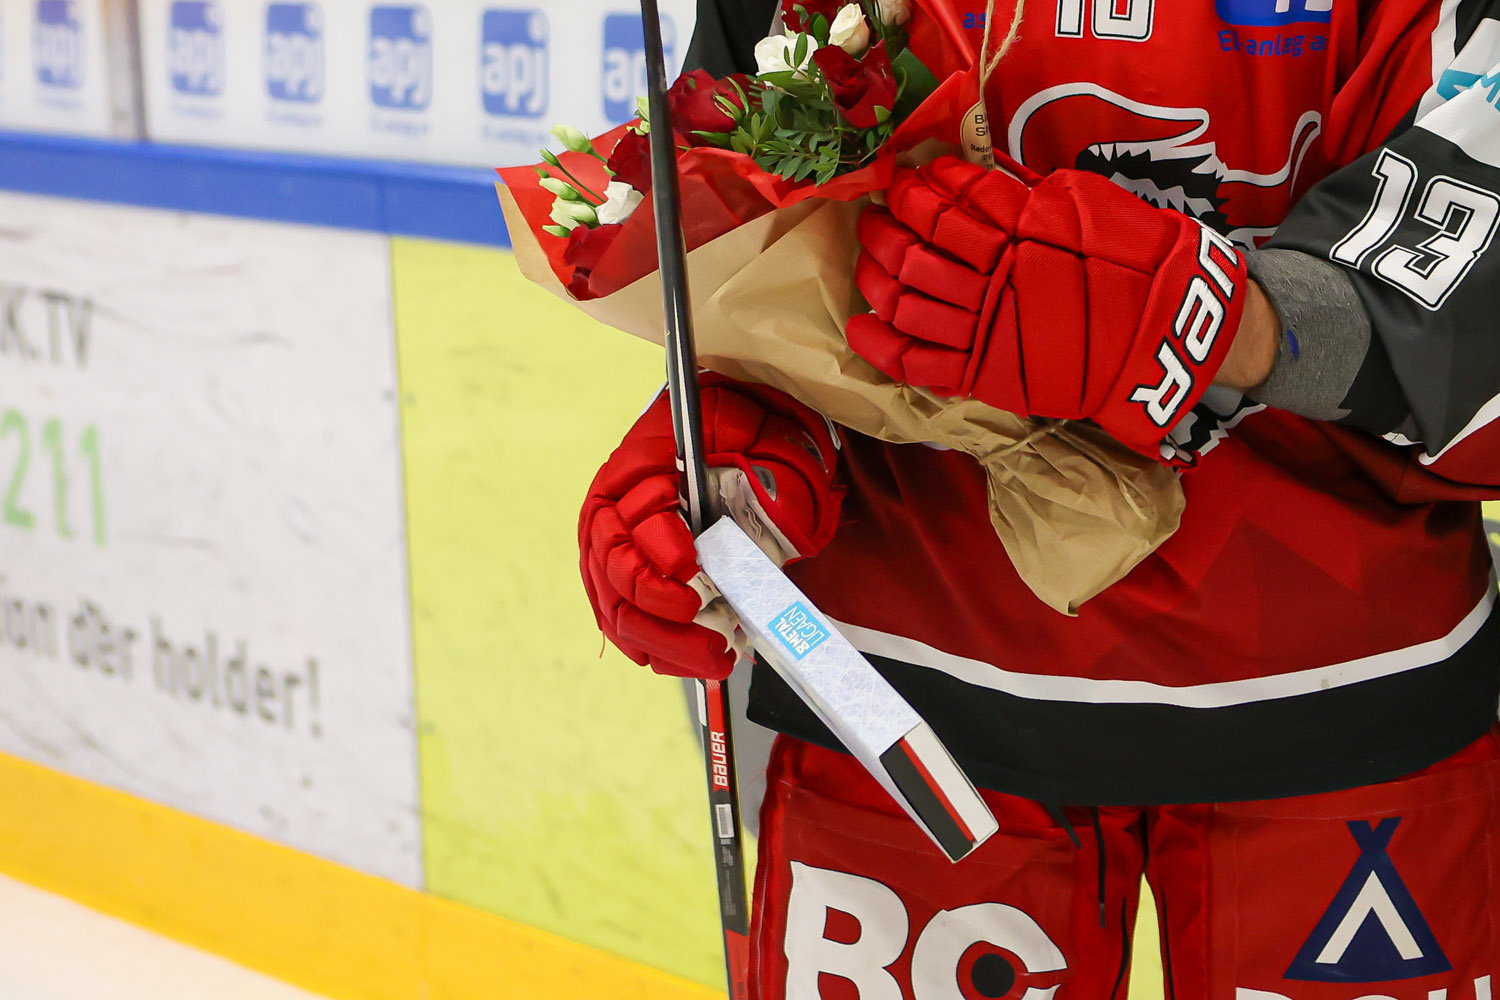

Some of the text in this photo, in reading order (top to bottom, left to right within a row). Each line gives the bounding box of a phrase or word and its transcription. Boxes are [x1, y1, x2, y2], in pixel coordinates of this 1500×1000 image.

[483, 42, 548, 112] apj
[1129, 216, 1238, 427] UER
[783, 605, 825, 647] LIGAEN
[151, 612, 322, 738] holder!
[711, 731, 729, 787] BAUER
